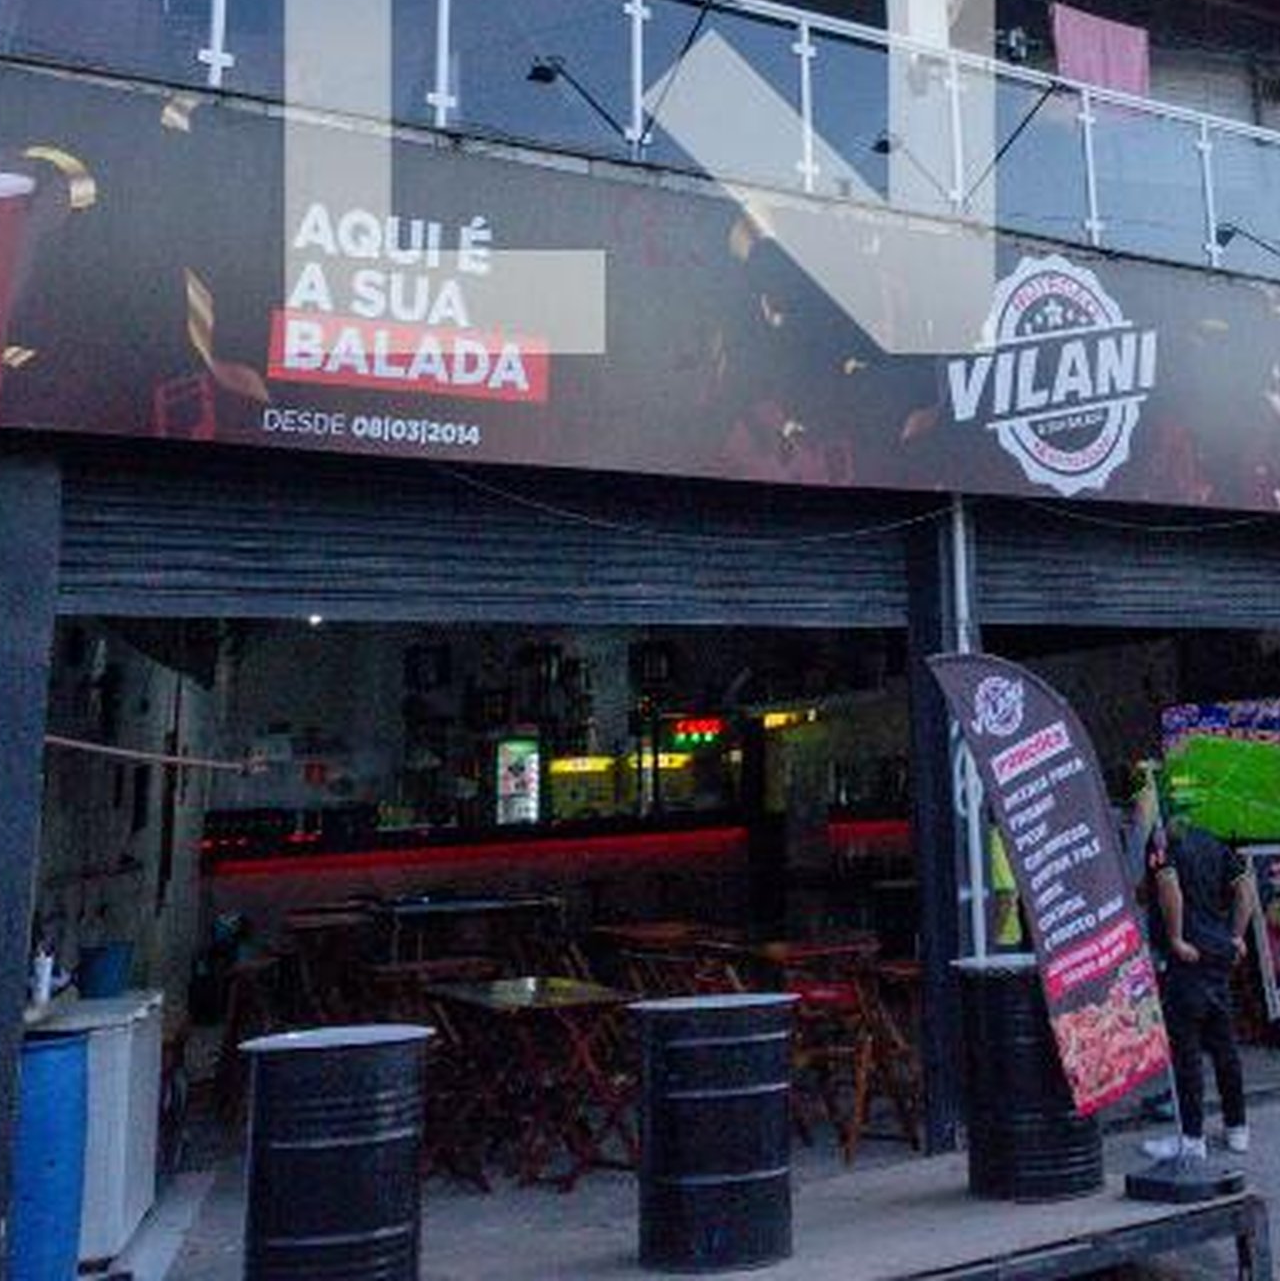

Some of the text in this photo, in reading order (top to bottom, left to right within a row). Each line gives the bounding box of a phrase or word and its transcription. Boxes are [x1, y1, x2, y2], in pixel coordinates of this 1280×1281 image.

[294, 203, 493, 275] AQUI É
[288, 262, 472, 328] A SUA
[283, 319, 530, 391] BALADA
[947, 329, 1158, 422] VILANI
[263, 409, 345, 435] DESDE
